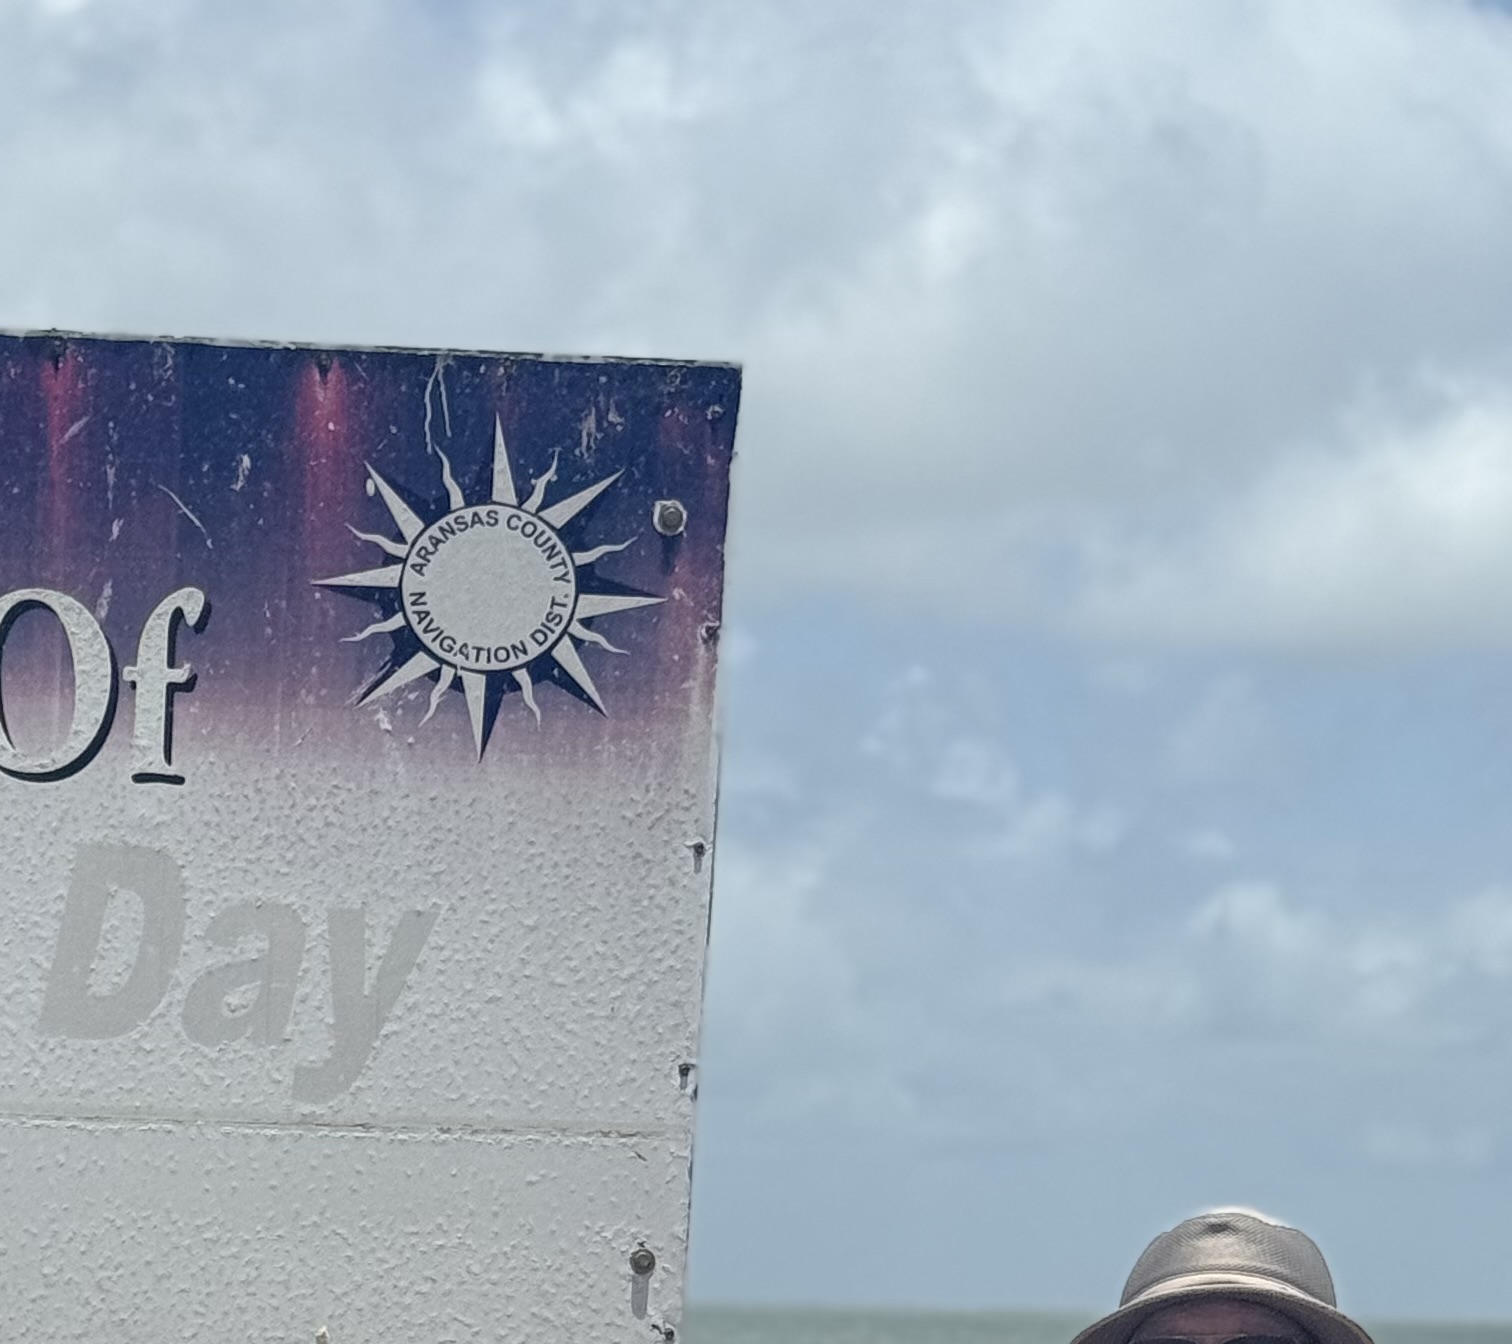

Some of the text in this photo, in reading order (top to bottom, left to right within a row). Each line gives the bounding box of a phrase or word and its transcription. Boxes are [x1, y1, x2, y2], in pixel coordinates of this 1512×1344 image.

[410, 510, 572, 586] ARANSAS COUNTY
[409, 590, 570, 664] NAVIGATION DIST.
[37, 839, 440, 1105] Day
